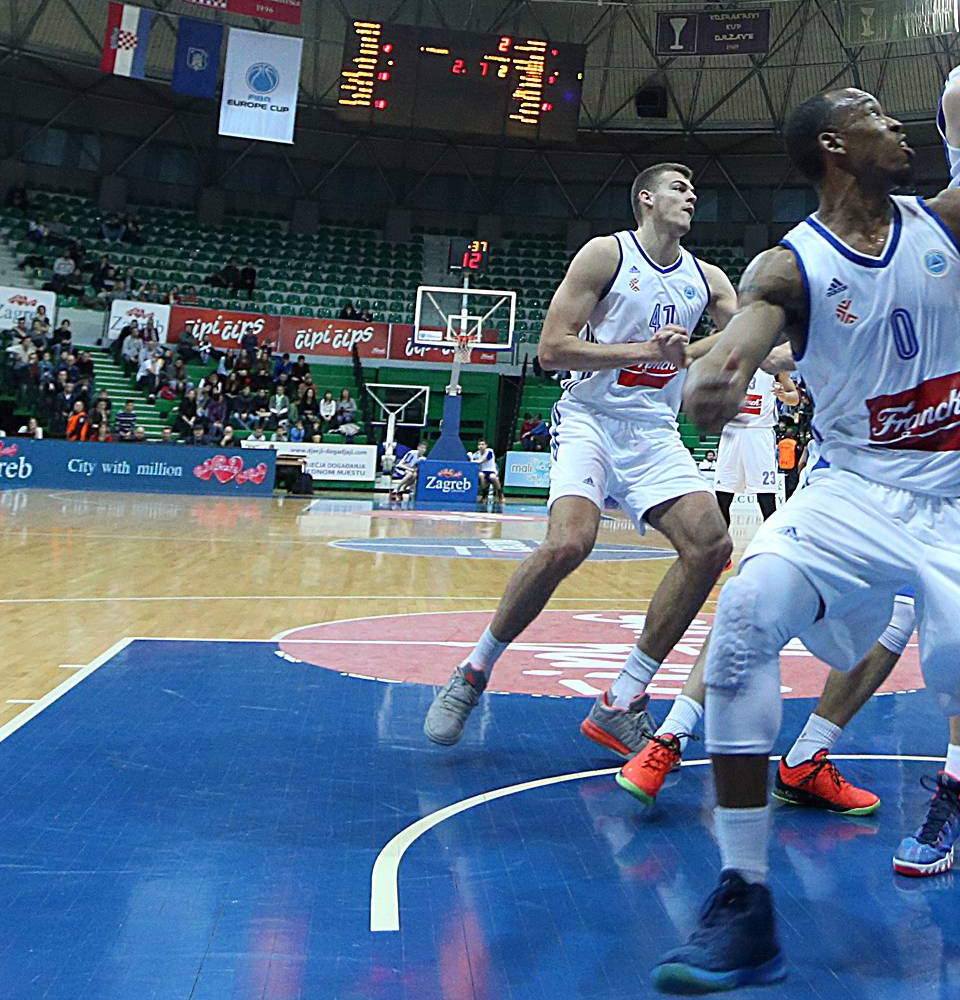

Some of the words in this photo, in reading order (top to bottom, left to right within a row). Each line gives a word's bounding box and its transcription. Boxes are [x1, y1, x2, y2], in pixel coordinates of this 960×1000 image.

[226, 99, 267, 111] EUROPE
[269, 104, 290, 113] CUP
[462, 251, 482, 269] 12
[890, 307, 920, 361] 0
[0, 456, 33, 479] reb
[67, 458, 97, 477] City
[101, 460, 131, 475] with
[136, 462, 183, 477] million
[425, 475, 472, 493] Zagreb
[762, 471, 776, 486] 23
